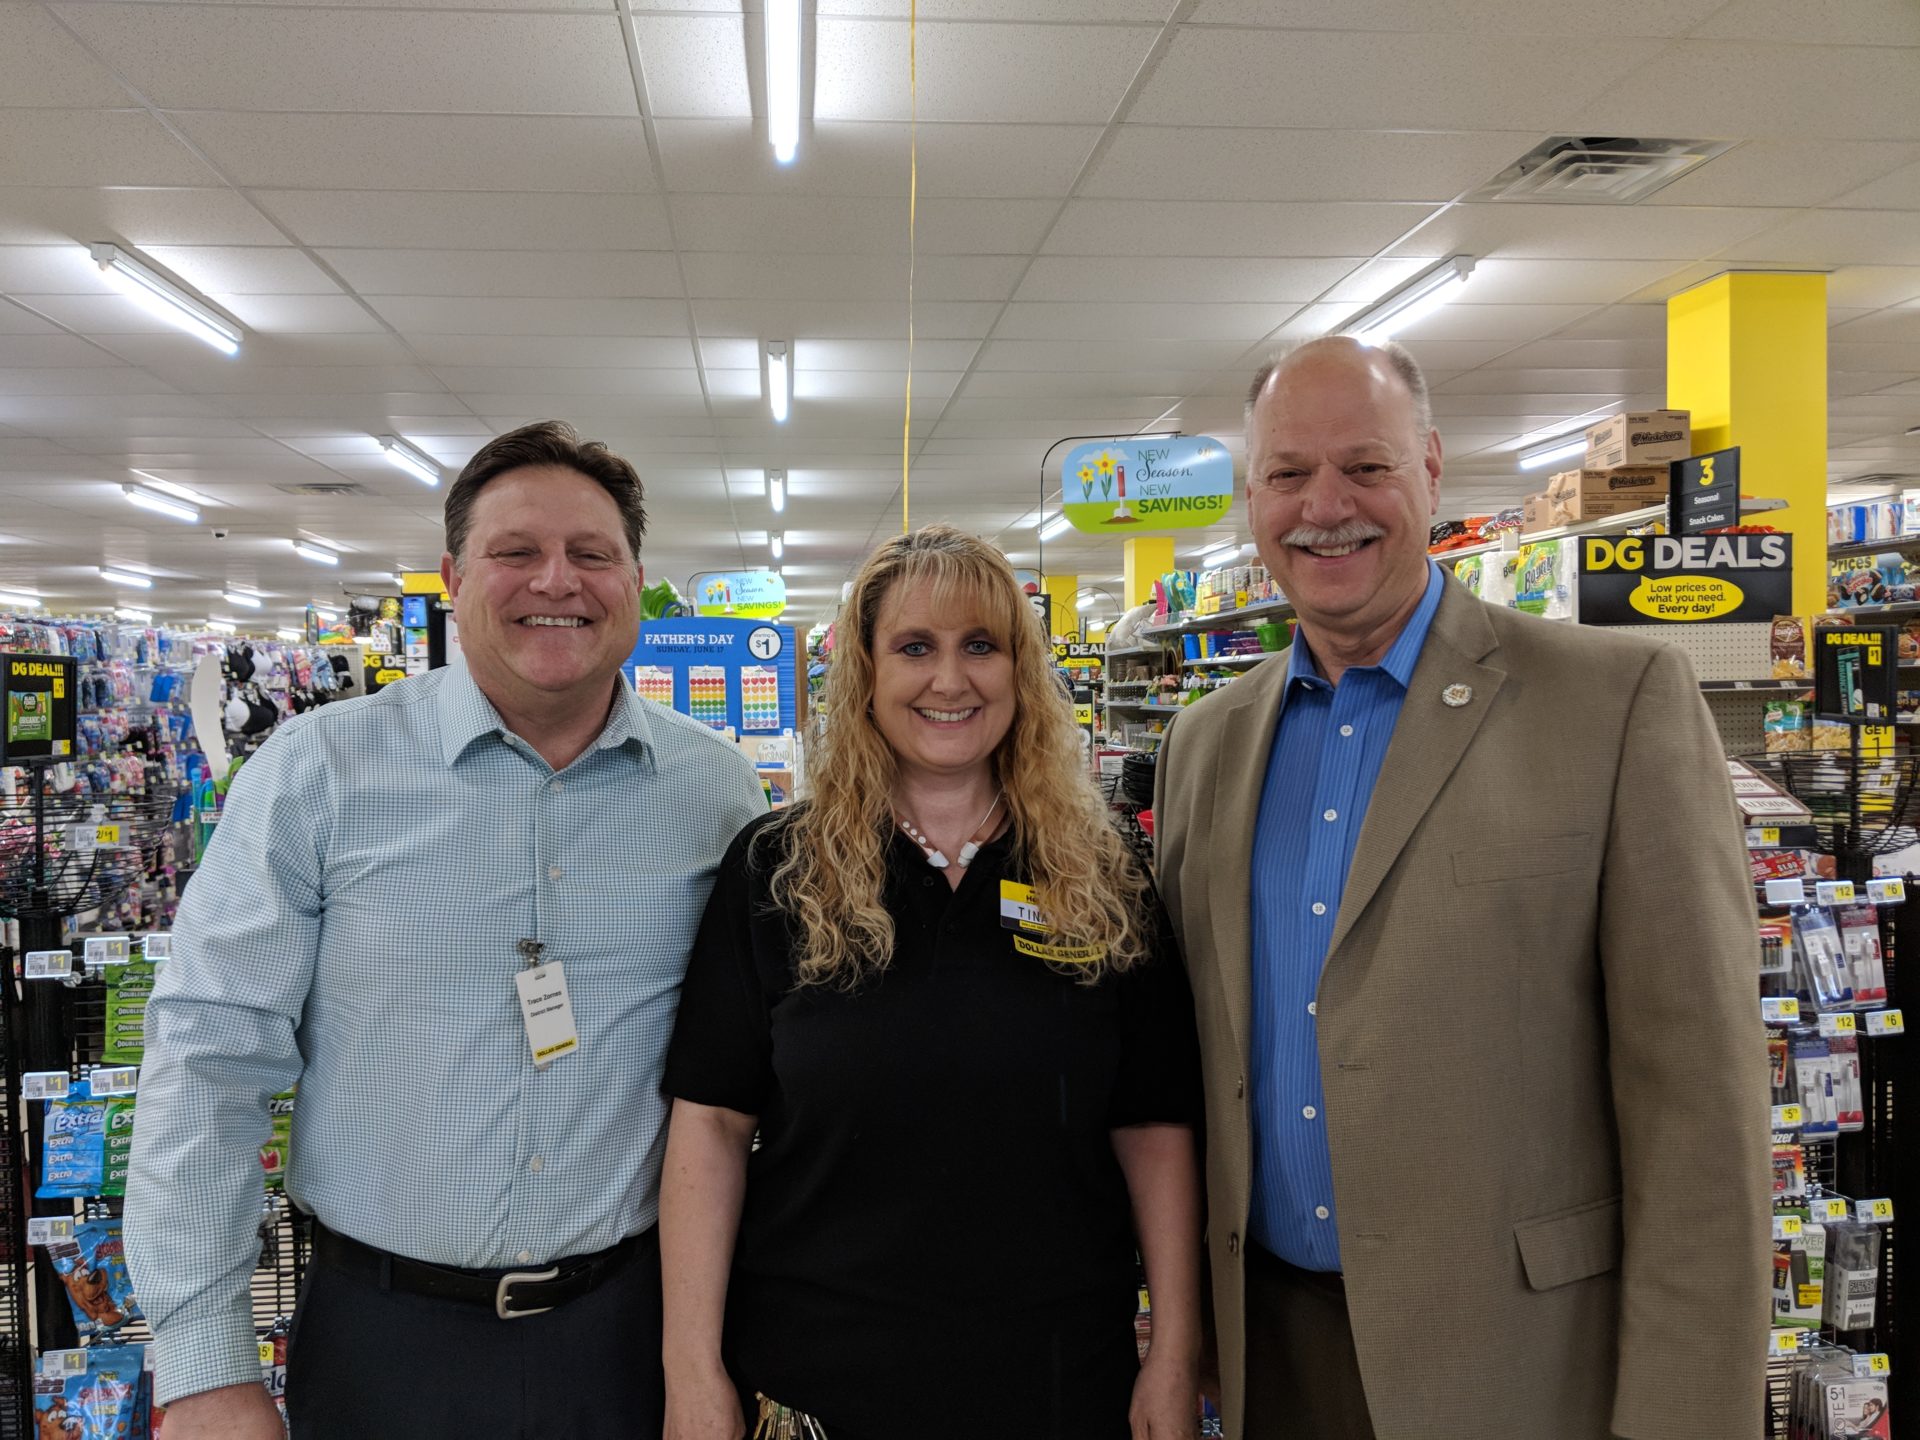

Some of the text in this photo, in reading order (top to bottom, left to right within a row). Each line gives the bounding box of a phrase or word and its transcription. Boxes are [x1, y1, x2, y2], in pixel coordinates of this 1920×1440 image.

[1138, 450, 1170, 460] NEW
[1699, 457, 1715, 486] 3
[1139, 484, 1171, 496] NEW
[1138, 495, 1223, 514] SAVINGS!
[1694, 493, 1719, 504] Seasonal
[1689, 513, 1725, 526] Snack Cakes
[1586, 536, 1785, 571] DG DEALS
[1650, 583, 1723, 596] Low prices on
[1647, 593, 1726, 606] what you need.
[737, 601, 781, 611] SAVINGS!
[1658, 604, 1715, 614] Every day!
[644, 633, 735, 645] FATHER'S DAY
[1827, 633, 1882, 645] DG DEAL!!!
[694, 646, 714, 654] JUNE
[756, 638, 770, 656] $1
[1871, 650, 1880, 663] $1
[12, 662, 64, 676] DG DEAL!!!
[1864, 725, 1888, 735] GET
[1872, 737, 1881, 759] 1
[1835, 886, 1851, 897] $12
[1887, 884, 1898, 895] $6
[111, 942, 123, 955] $1
[52, 955, 65, 969] $1
[1836, 1017, 1852, 1027] $12
[1886, 1015, 1897, 1026] $6
[49, 1077, 62, 1090] $1
[117, 1071, 129, 1085] $1
[55, 1110, 104, 1133] Extra
[49, 1138, 74, 1149] Extra
[48, 1153, 73, 1165] Extra
[48, 1170, 73, 1181] Extra
[1830, 1203, 1840, 1215] $7
[1876, 1203, 1886, 1215] $3
[54, 1221, 67, 1235] $1
[67, 1353, 80, 1368] $1
[1873, 1358, 1883, 1370] $5
